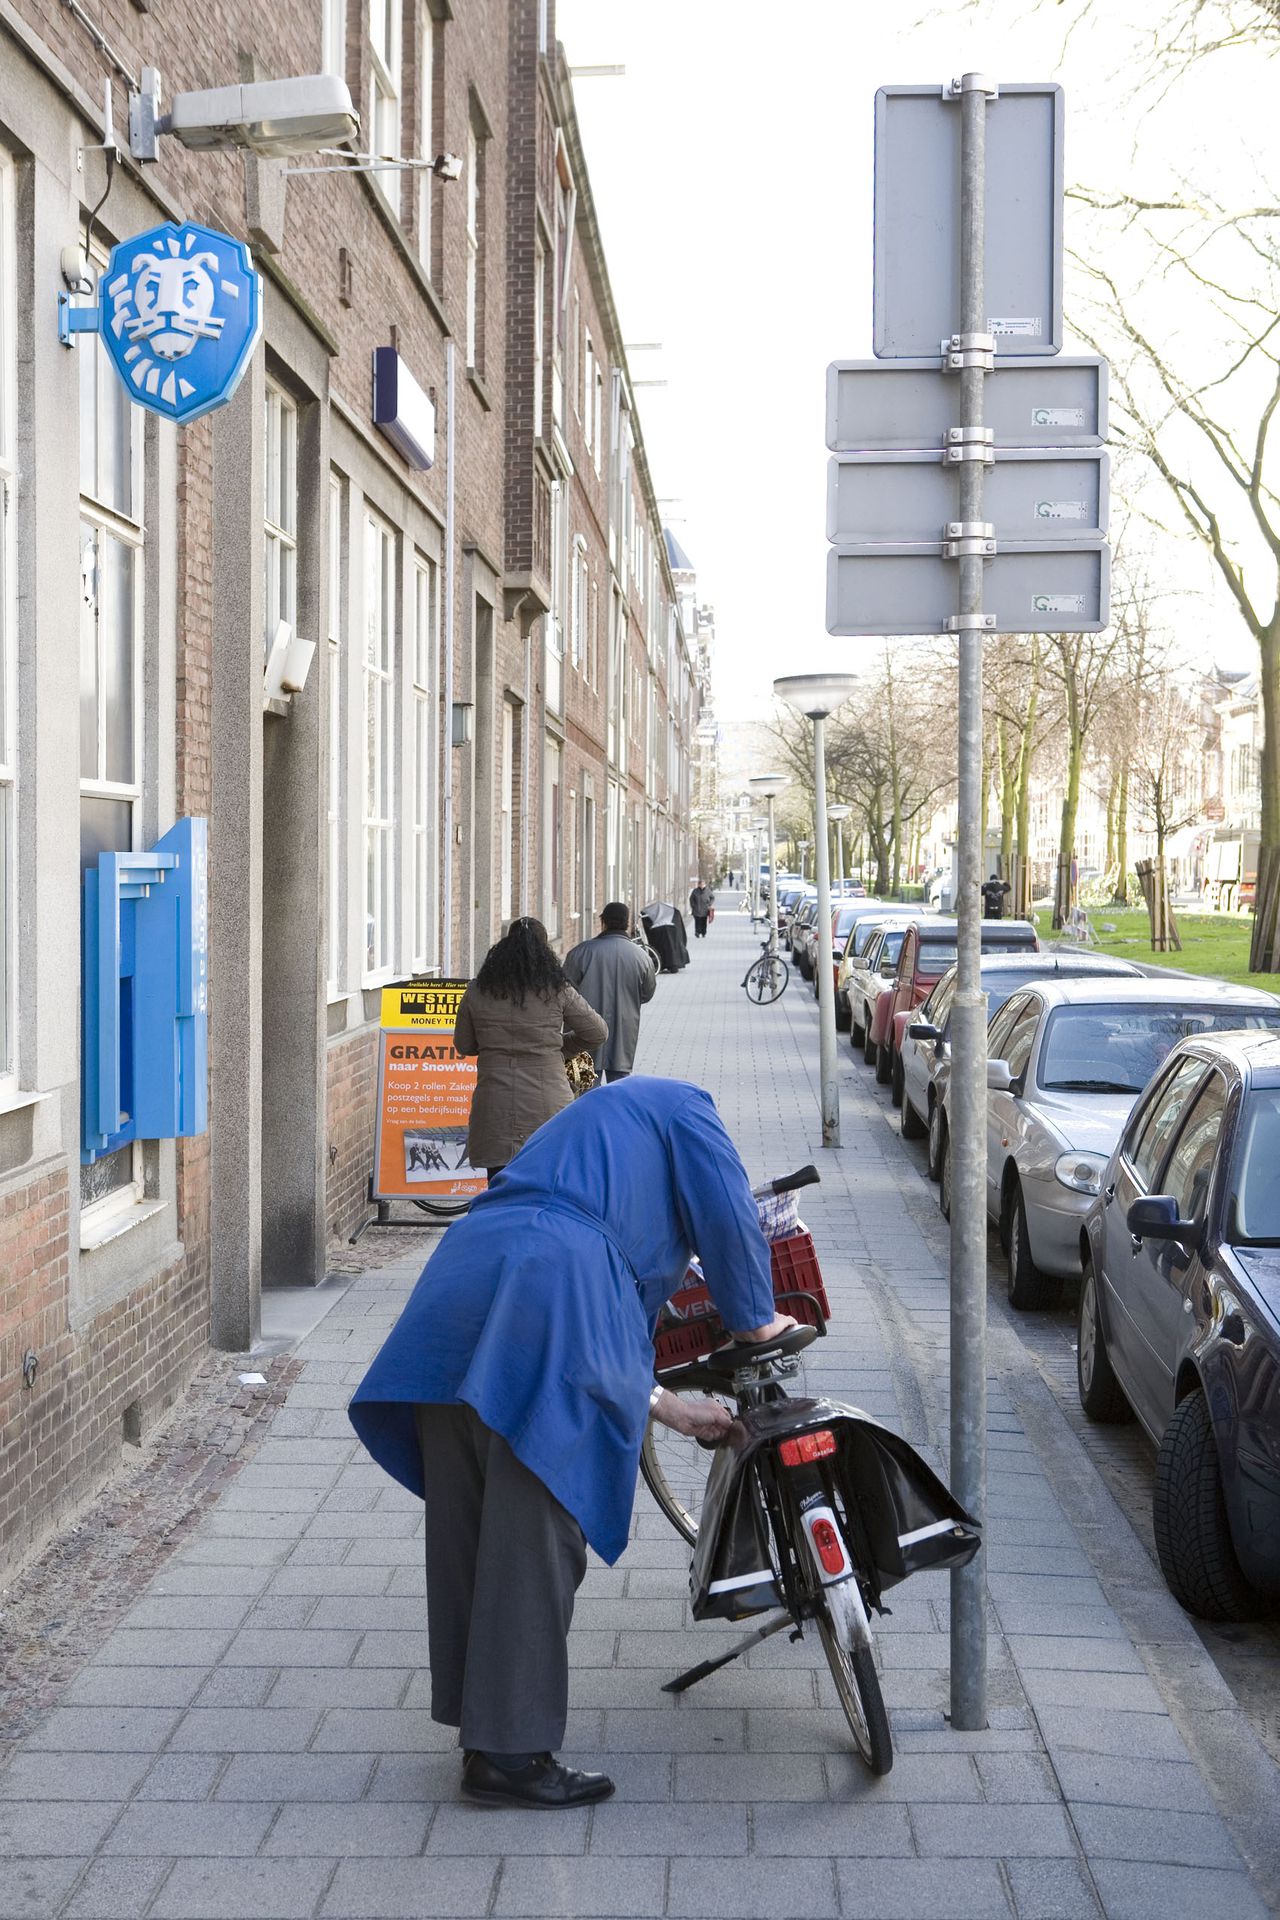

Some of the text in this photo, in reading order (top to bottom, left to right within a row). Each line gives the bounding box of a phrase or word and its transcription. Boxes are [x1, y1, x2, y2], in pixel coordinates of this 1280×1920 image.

[411, 1017, 456, 1025] MONEY TR
[388, 1062, 419, 1072] naar
[388, 1081, 411, 1092] Koop
[413, 1081, 420, 1090] 2
[422, 1081, 447, 1091] rollen
[387, 1094, 431, 1104] postzegels
[446, 1095, 469, 1103] maak
[386, 1106, 398, 1114] op
